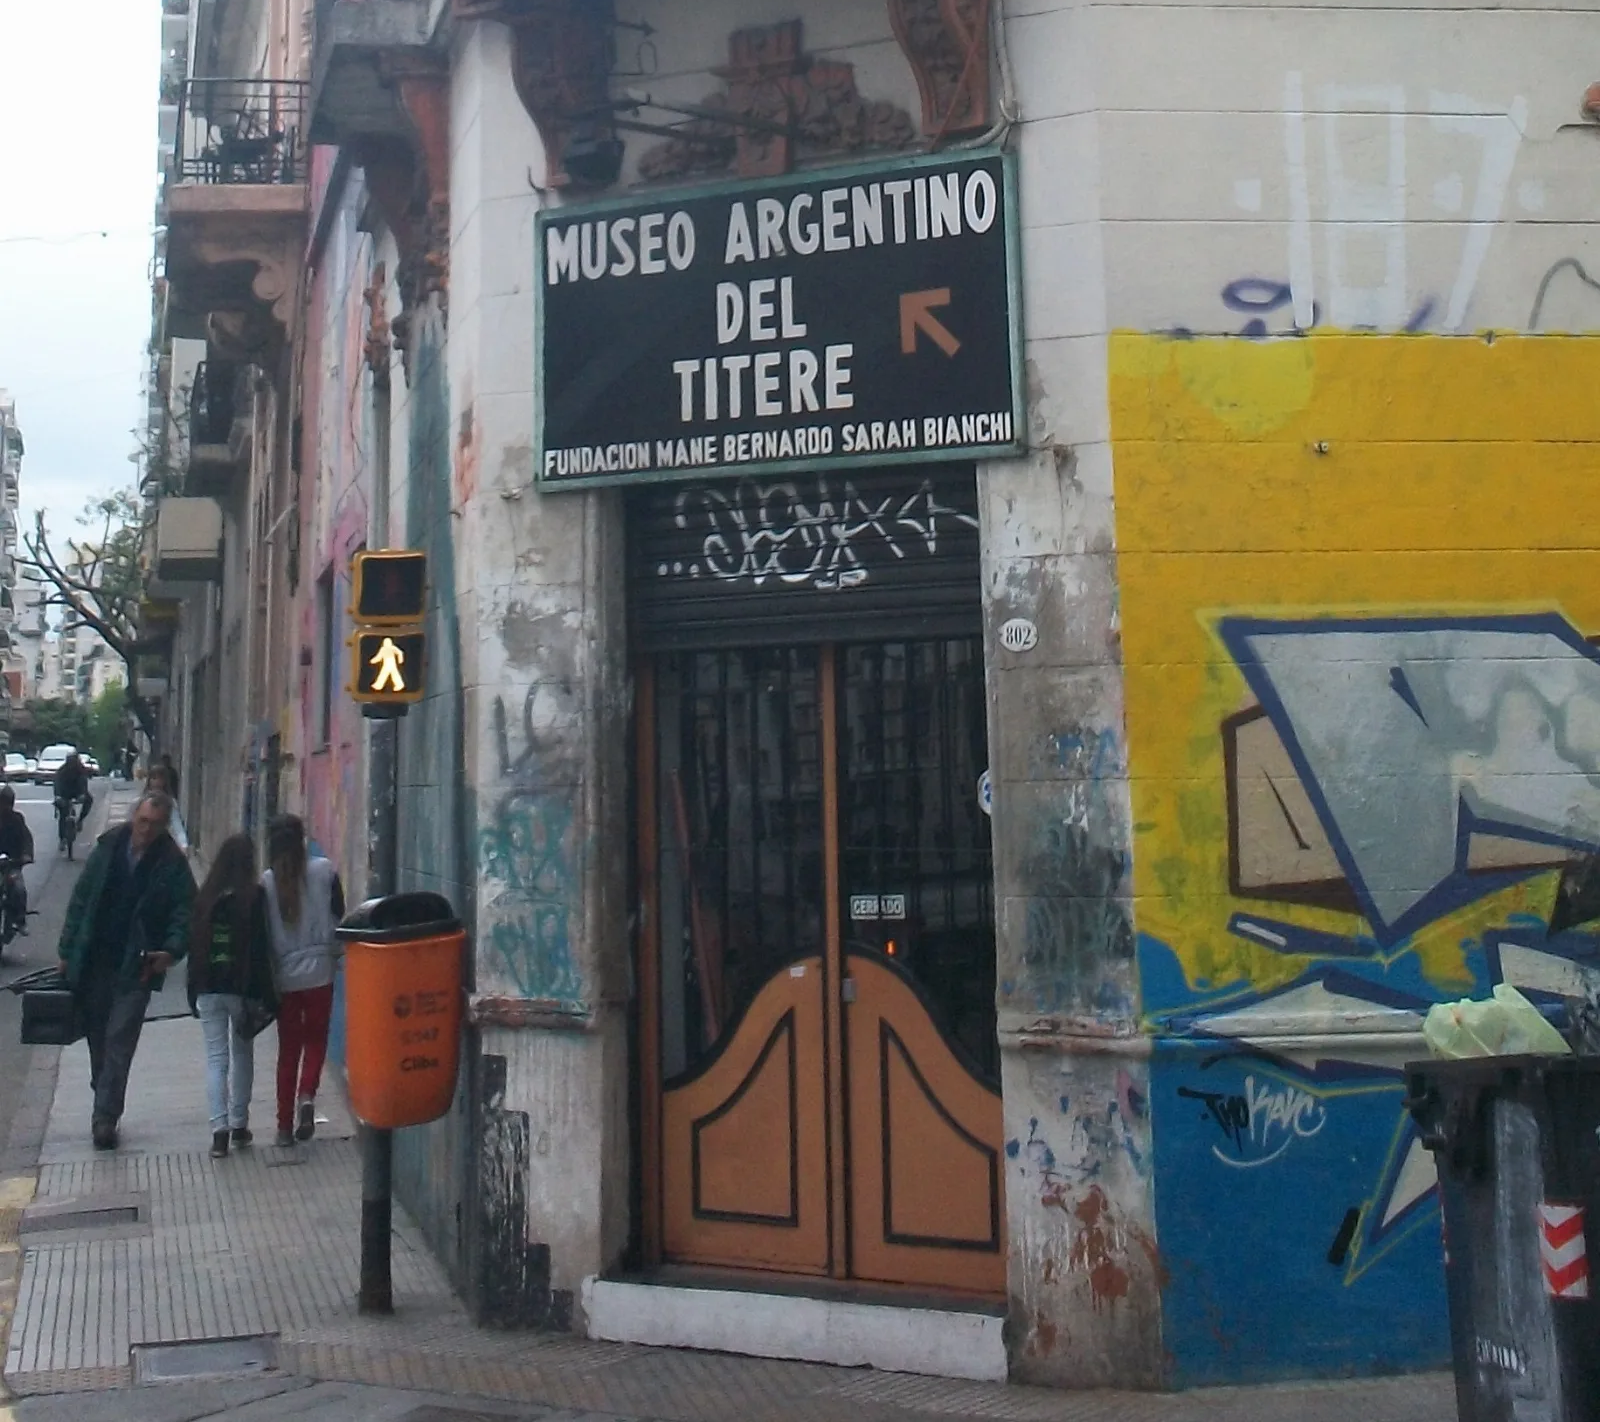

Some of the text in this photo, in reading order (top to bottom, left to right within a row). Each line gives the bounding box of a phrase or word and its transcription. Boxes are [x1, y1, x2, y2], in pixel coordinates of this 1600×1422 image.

[546, 169, 997, 285] MUSEO ARGENTINO
[716, 276, 807, 344] DEL
[672, 343, 854, 422] TITERE
[544, 411, 1011, 477] FUNDACION MANE BERNARDO SARAH BIANCHI
[1006, 626, 1031, 646] 802
